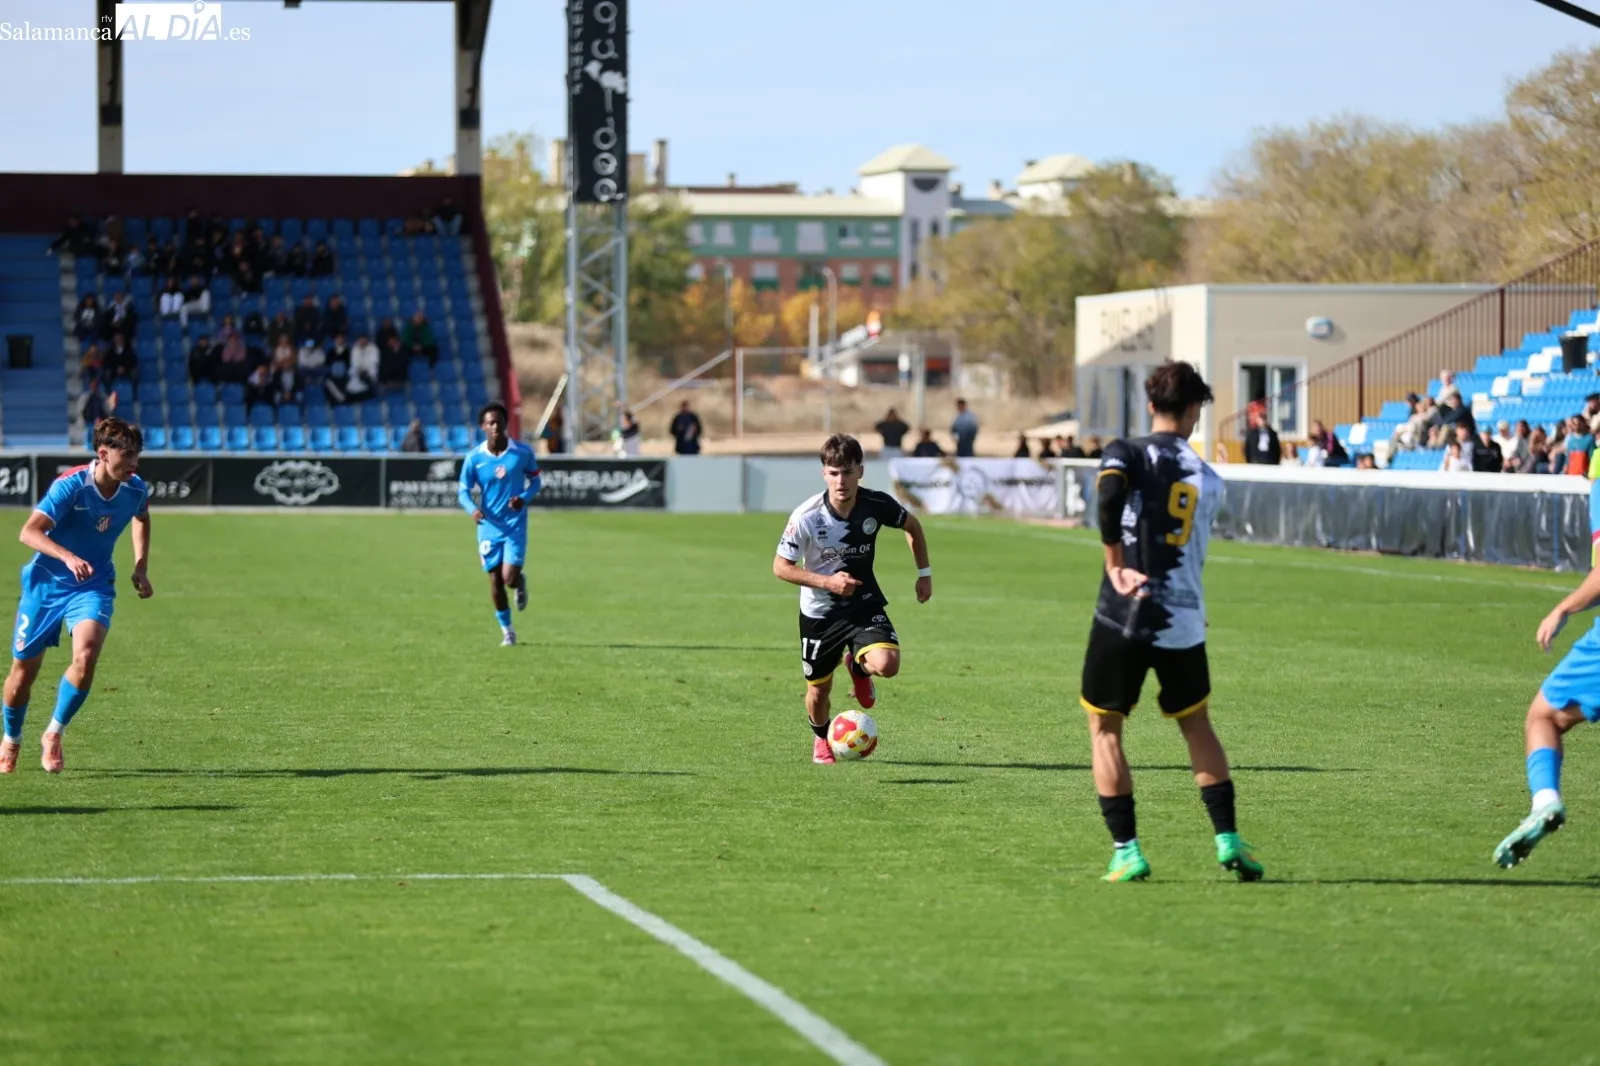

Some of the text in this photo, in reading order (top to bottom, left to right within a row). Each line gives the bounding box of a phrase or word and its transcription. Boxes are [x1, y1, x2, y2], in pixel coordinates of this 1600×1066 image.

[1165, 481, 1199, 547] 9
[18, 613, 29, 639] 2
[802, 637, 821, 660] 17
